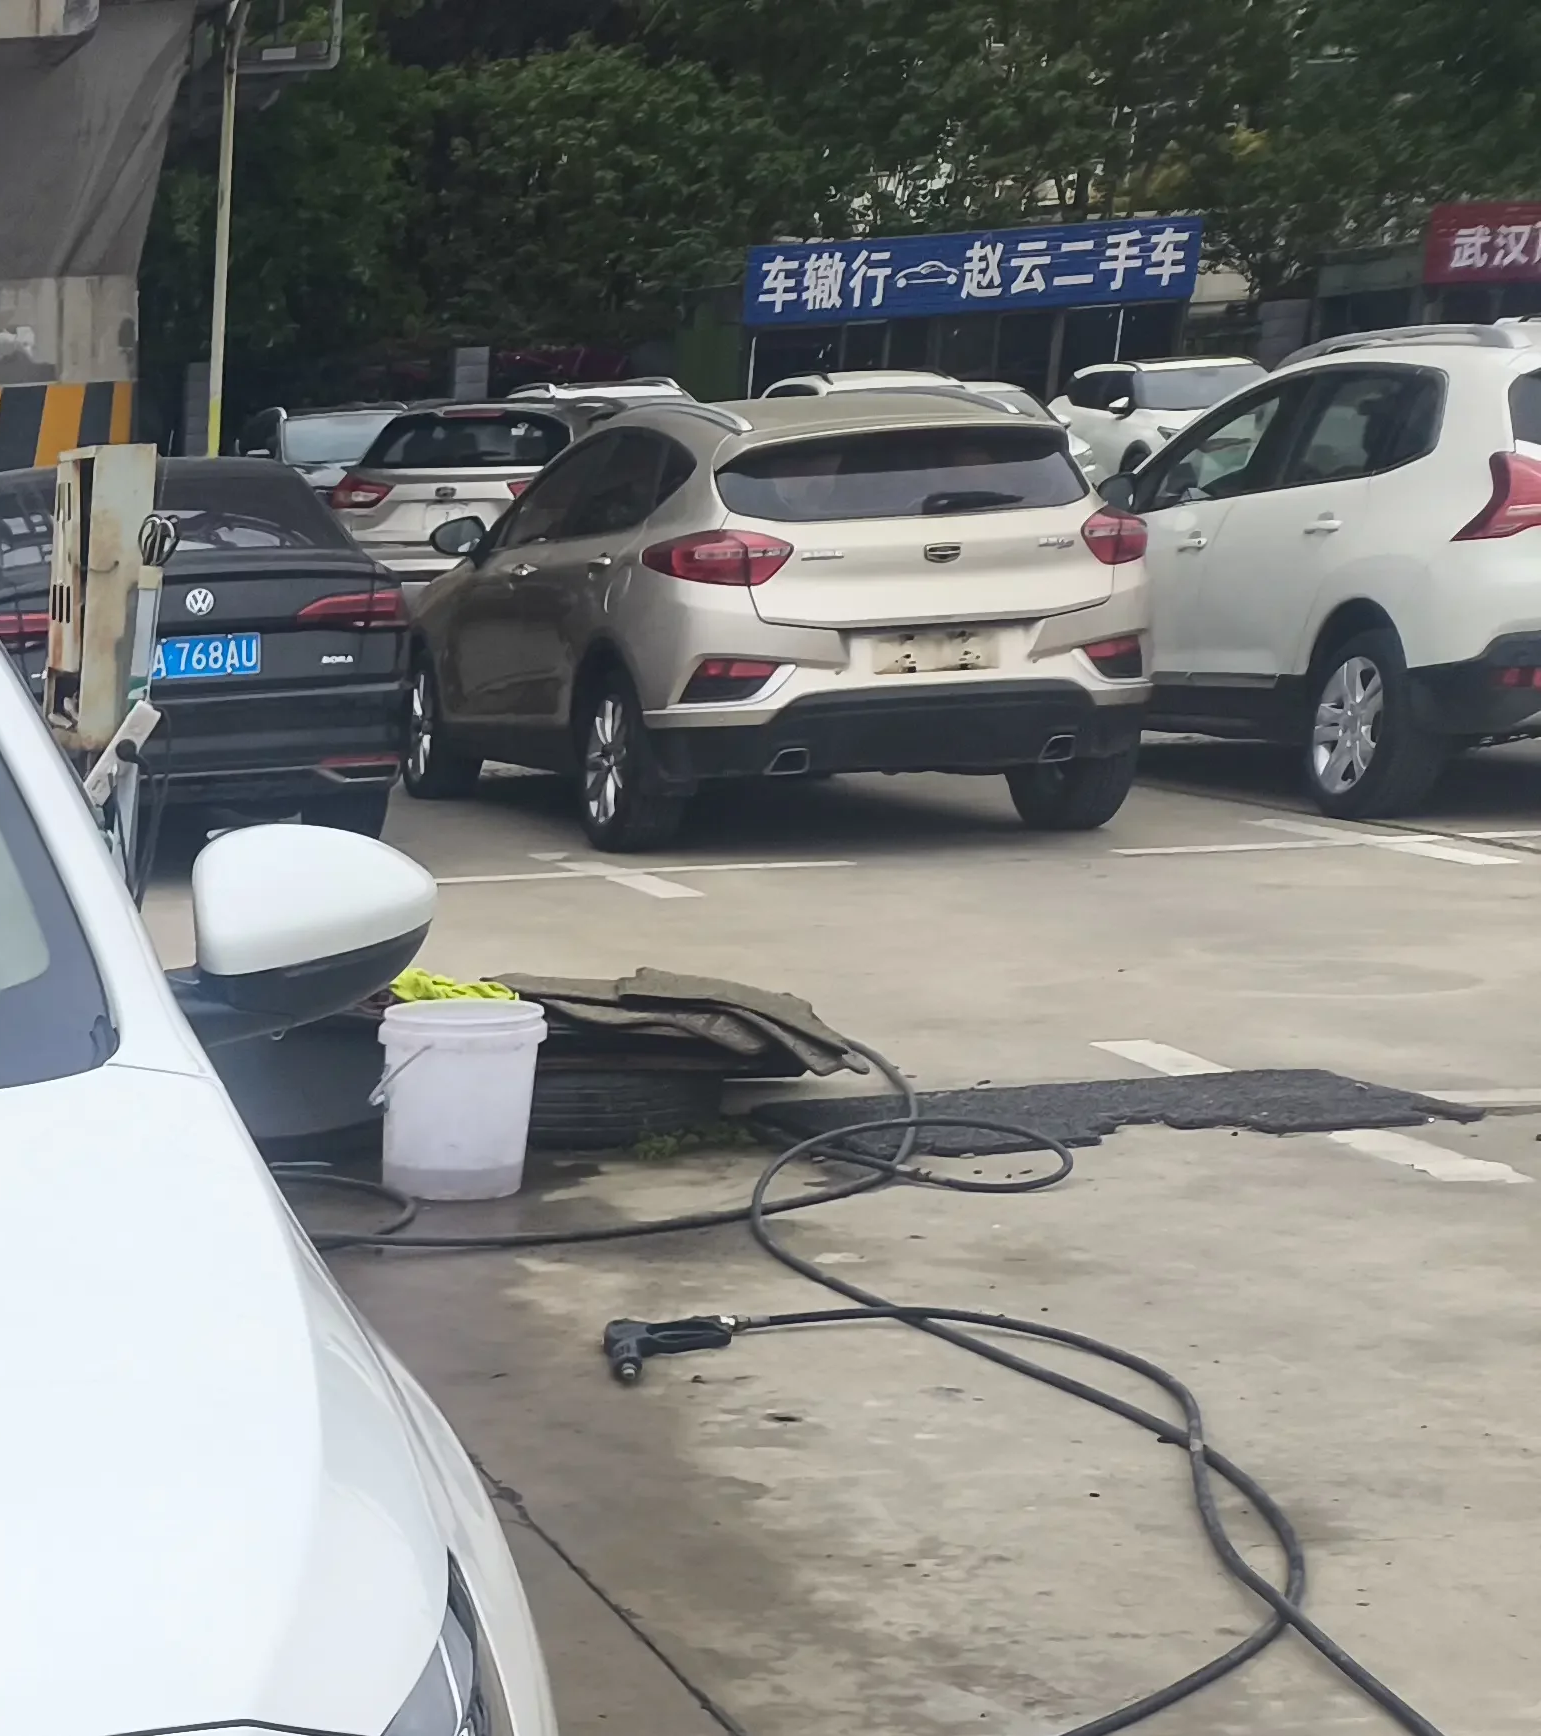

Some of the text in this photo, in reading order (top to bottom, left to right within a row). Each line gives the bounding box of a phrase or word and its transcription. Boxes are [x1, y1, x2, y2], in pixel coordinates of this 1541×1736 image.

[757, 227, 1189, 313] 车辙行 赵云二手车
[1450, 220, 1541, 268] 武汉
